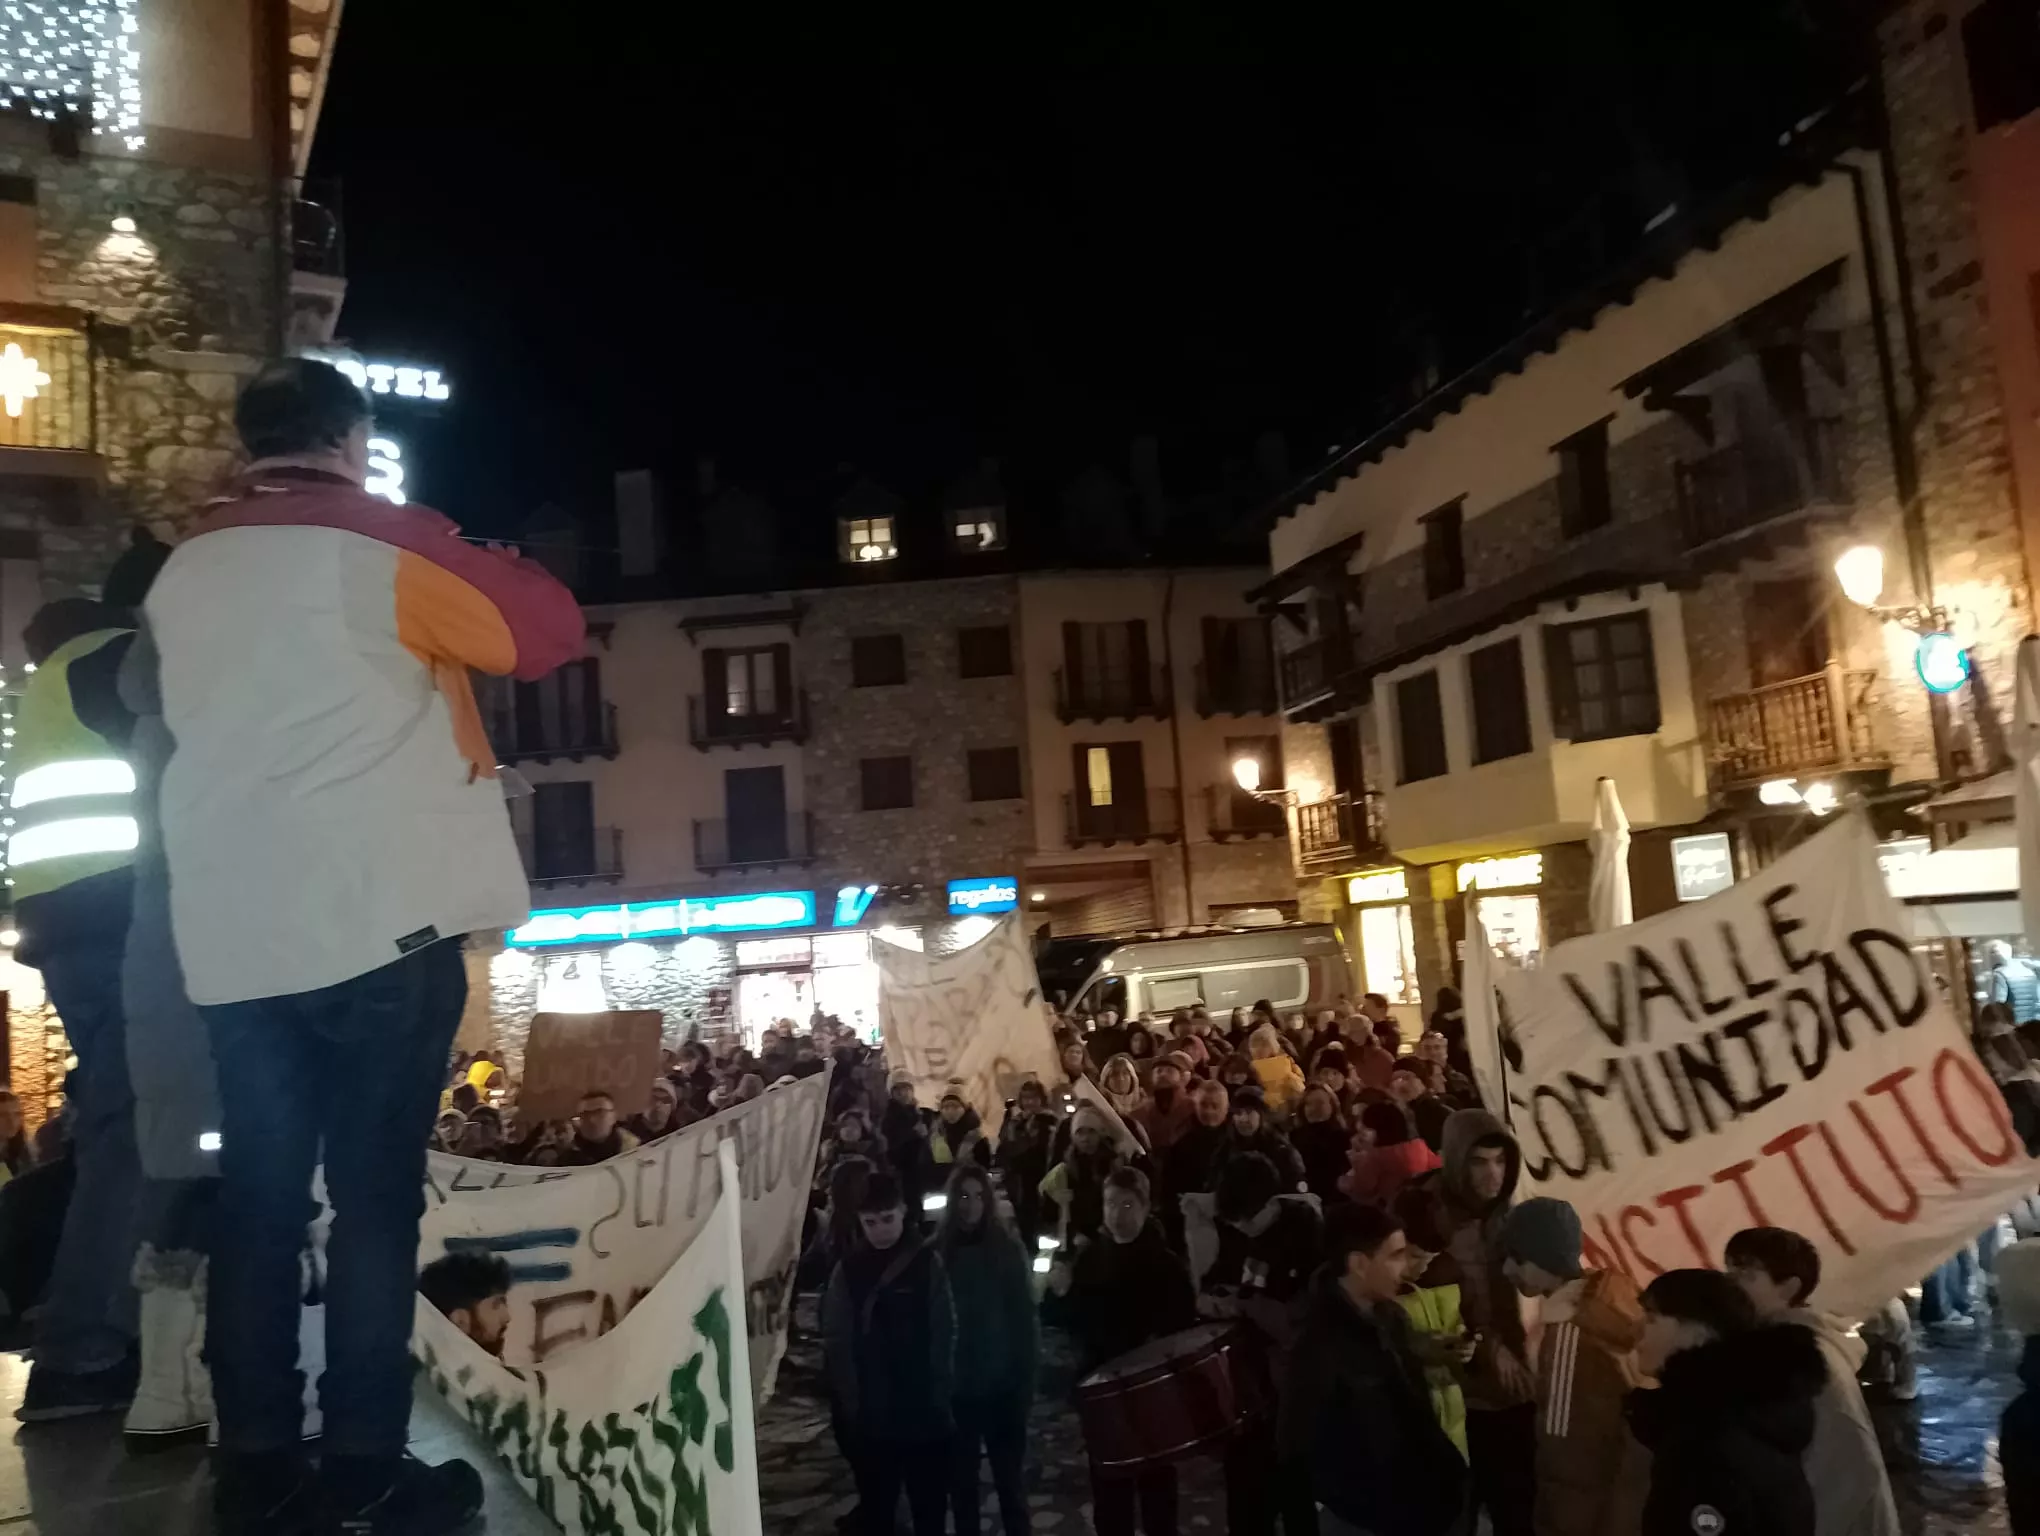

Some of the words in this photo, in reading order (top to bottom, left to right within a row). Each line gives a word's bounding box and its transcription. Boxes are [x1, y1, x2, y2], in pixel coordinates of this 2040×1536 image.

[318, 355, 449, 400] OTEL
[948, 884, 1017, 908] regalos
[1560, 884, 1821, 1048] VALLE
[1580, 1047, 2017, 1287] NSTITUTO
